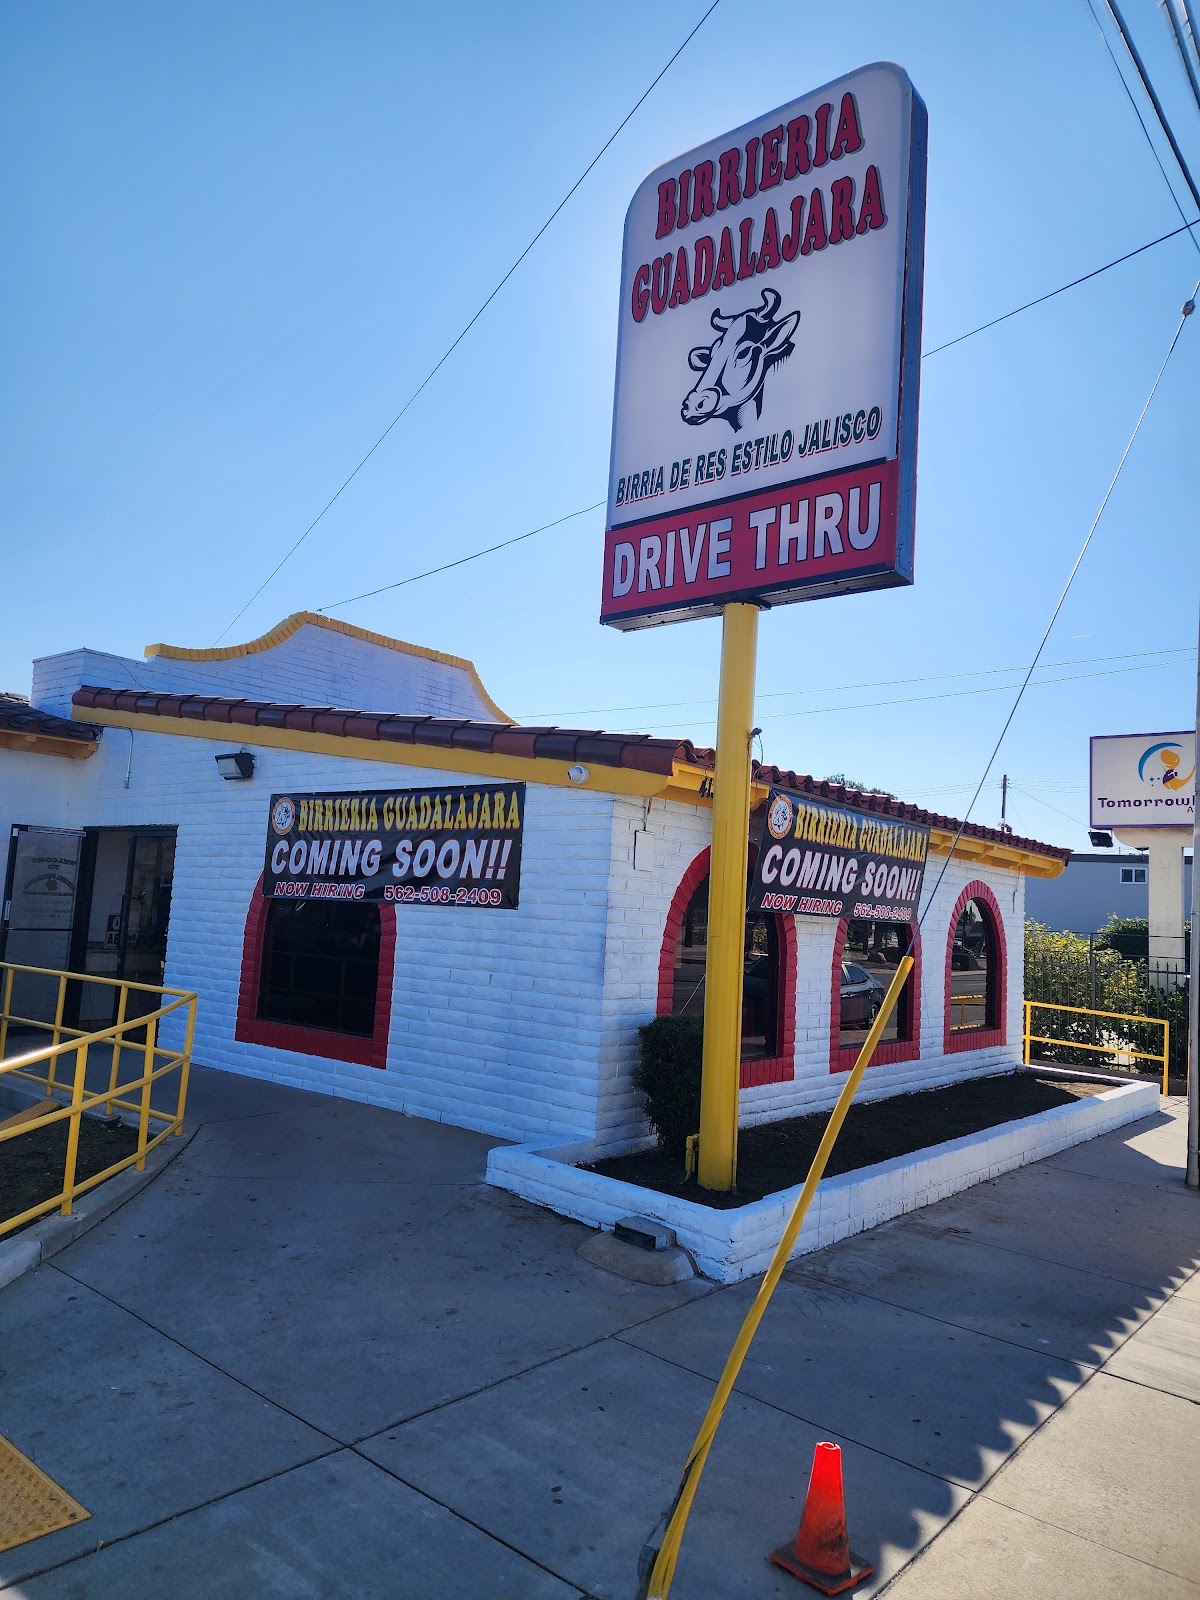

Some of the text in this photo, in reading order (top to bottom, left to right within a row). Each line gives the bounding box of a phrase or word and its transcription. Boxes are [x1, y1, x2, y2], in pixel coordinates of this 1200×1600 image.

[655, 92, 864, 240] BIRRIERIA
[631, 165, 888, 324] GUADALAJARA
[616, 406, 883, 507] BIRRIA DE RES ESTILO JALISCO
[611, 482, 882, 599] DRIVE THRU
[298, 797, 379, 832] BIRRIERIA
[382, 790, 521, 831] GUADALAJARA
[794, 802, 858, 850] BIRRIERIA
[859, 818, 928, 863] GUADALAJARA
[271, 838, 513, 880] COMING SOON!!
[761, 844, 922, 901] COMING SOON!!
[274, 881, 502, 906] NOW HIRING 562-508-2409
[760, 892, 797, 911] NOW
[798, 896, 843, 915] HIRING
